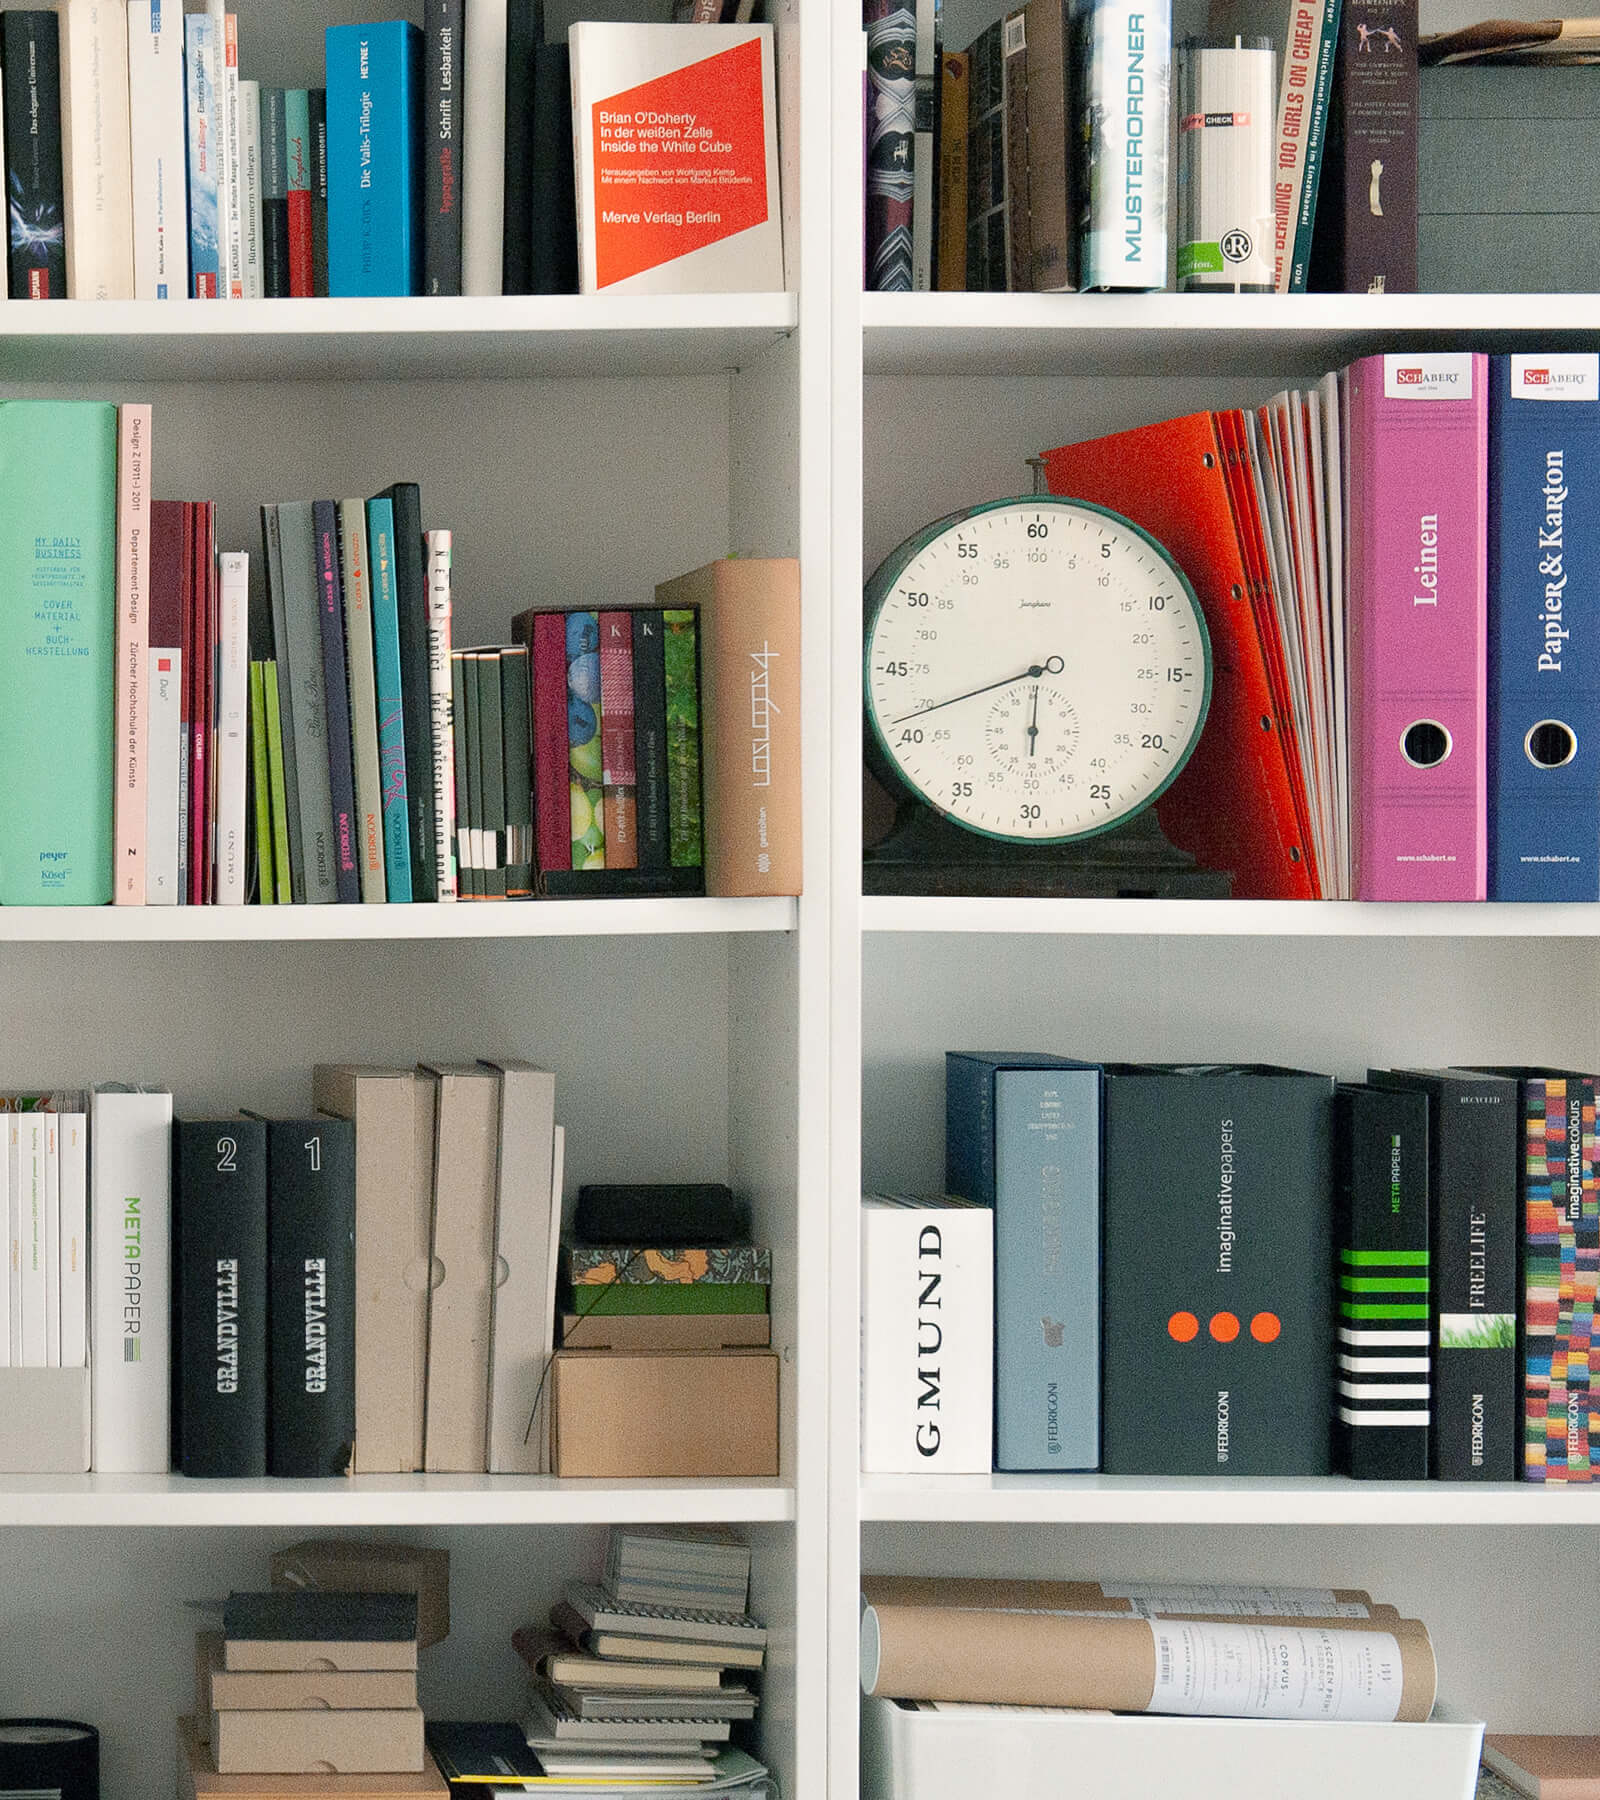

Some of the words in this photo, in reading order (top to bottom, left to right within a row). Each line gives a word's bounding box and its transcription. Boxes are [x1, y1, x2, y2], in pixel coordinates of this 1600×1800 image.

[1292, 8, 1314, 60] CHEAP
[28, 40, 38, 84] Universum
[439, 27, 452, 91] Lesbarkeit
[1287, 64, 1308, 88] ON
[29, 85, 40, 118] elegante
[1310, 39, 1332, 148] Multichannel-Retailing
[30, 118, 39, 135] Das
[361, 91, 372, 167] Valis-Trilogie
[439, 98, 452, 140] Schrift
[599, 111, 632, 124] Brian
[635, 111, 697, 127] O'Doherty
[1205, 116, 1234, 124] CHECK
[1282, 92, 1304, 137] GIRLS
[600, 126, 612, 138] In
[614, 126, 634, 138] der
[637, 126, 681, 138] weißen
[683, 126, 714, 139] Zelle
[600, 141, 637, 153] Inside
[639, 141, 659, 153] the
[662, 141, 697, 153] White
[699, 141, 733, 153] Cube
[1125, 13, 1145, 262] MUSTERORDNER
[245, 145, 254, 191] verbiegen
[1278, 141, 1298, 170] 100
[360, 169, 372, 189] Die
[439, 147, 454, 214] Typografie
[602, 211, 641, 223] Merve
[643, 211, 684, 225] Verlag
[686, 211, 721, 223] Berlin
[131, 418, 142, 449] Design
[131, 491, 141, 511] 2011
[1027, 524, 1048, 539] 60
[35, 548, 81, 558] BUSINESS
[129, 528, 141, 590] Departement
[957, 543, 978, 558] 55
[1101, 544, 1111, 559] 5
[1414, 513, 1438, 607] Leinen
[1538, 552, 1563, 577] &
[434, 550, 445, 610] NEON
[34, 611, 81, 621] MATERIAL
[43, 600, 73, 609] COVER
[129, 592, 140, 625] Design
[907, 592, 929, 607] 50
[1148, 596, 1165, 611] 10
[25, 646, 89, 657] HERSTELLUNG
[128, 641, 139, 680] Zürcher
[885, 662, 908, 677] 45
[1167, 668, 1183, 683] 15
[128, 681, 138, 736] Hochschule
[431, 693, 441, 713] THE
[128, 738, 138, 754] der
[901, 729, 924, 744] 40
[1141, 735, 1163, 750] 20
[128, 756, 138, 789] Künste
[952, 783, 973, 798] 35
[1090, 785, 1111, 800] 25
[1020, 804, 1041, 819] 30
[339, 813, 351, 860] FEDRIGONI
[366, 813, 377, 861] FEDRIGONI
[1396, 854, 1457, 863] www.schabert.eu
[1519, 854, 1581, 863] www.schabert.eu
[217, 1137, 237, 1171] 2
[304, 1137, 321, 1171] 1
[1567, 1099, 1582, 1220] imaginativecolours
[1215, 1118, 1237, 1273] imaginativepapers
[1391, 1148, 1401, 1214] METAPAPER
[124, 1197, 141, 1335] METAPAPER
[216, 1258, 238, 1394] GRANDVILLE
[305, 1258, 326, 1394] GRANDVILLE
[914, 1224, 943, 1457] GMUND
[1047, 1382, 1059, 1443] FEDRIGONI
[1217, 1390, 1230, 1453] FEDRIGONI
[1471, 1394, 1484, 1456] FEDRIGONI
[1567, 1392, 1580, 1452] FEDRIGONI
[1279, 1644, 1290, 1690] CORVUS
